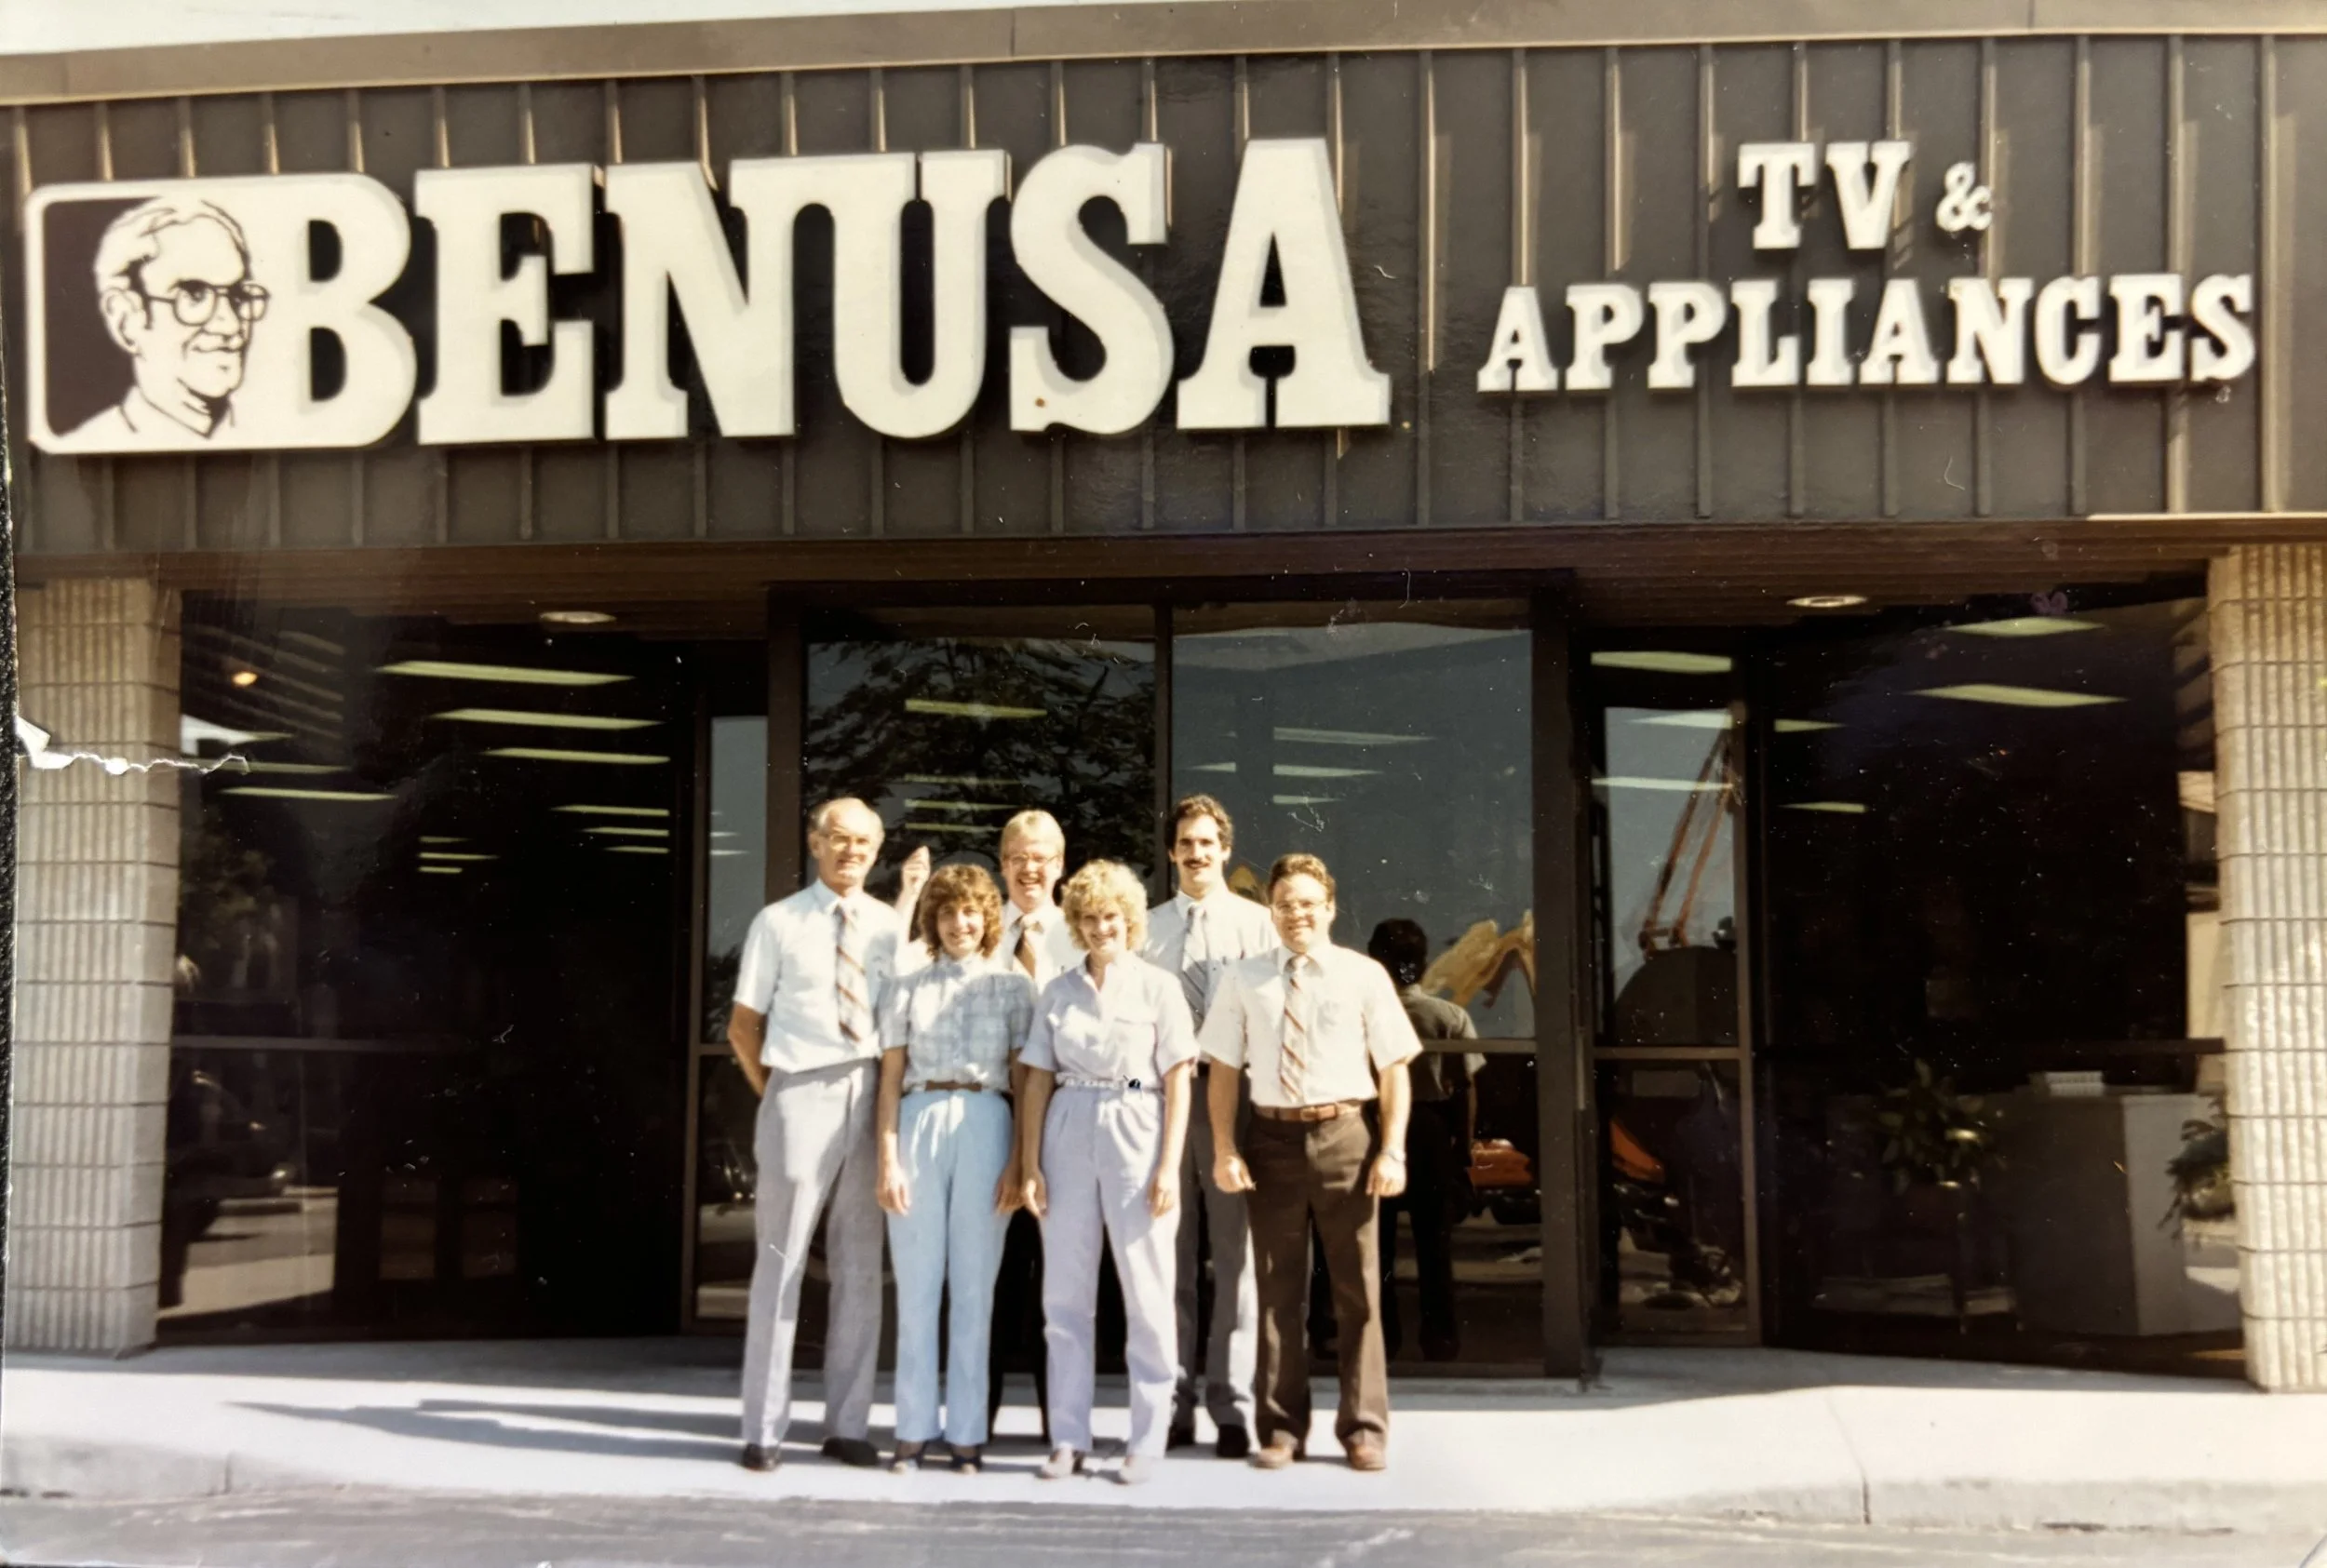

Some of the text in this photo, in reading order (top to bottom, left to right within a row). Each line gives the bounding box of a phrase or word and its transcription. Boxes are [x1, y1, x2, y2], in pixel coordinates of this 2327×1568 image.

[1738, 141, 1994, 250] TV &
[270, 137, 1392, 452] BENUSA
[1477, 273, 2256, 394] APPLIANCES
